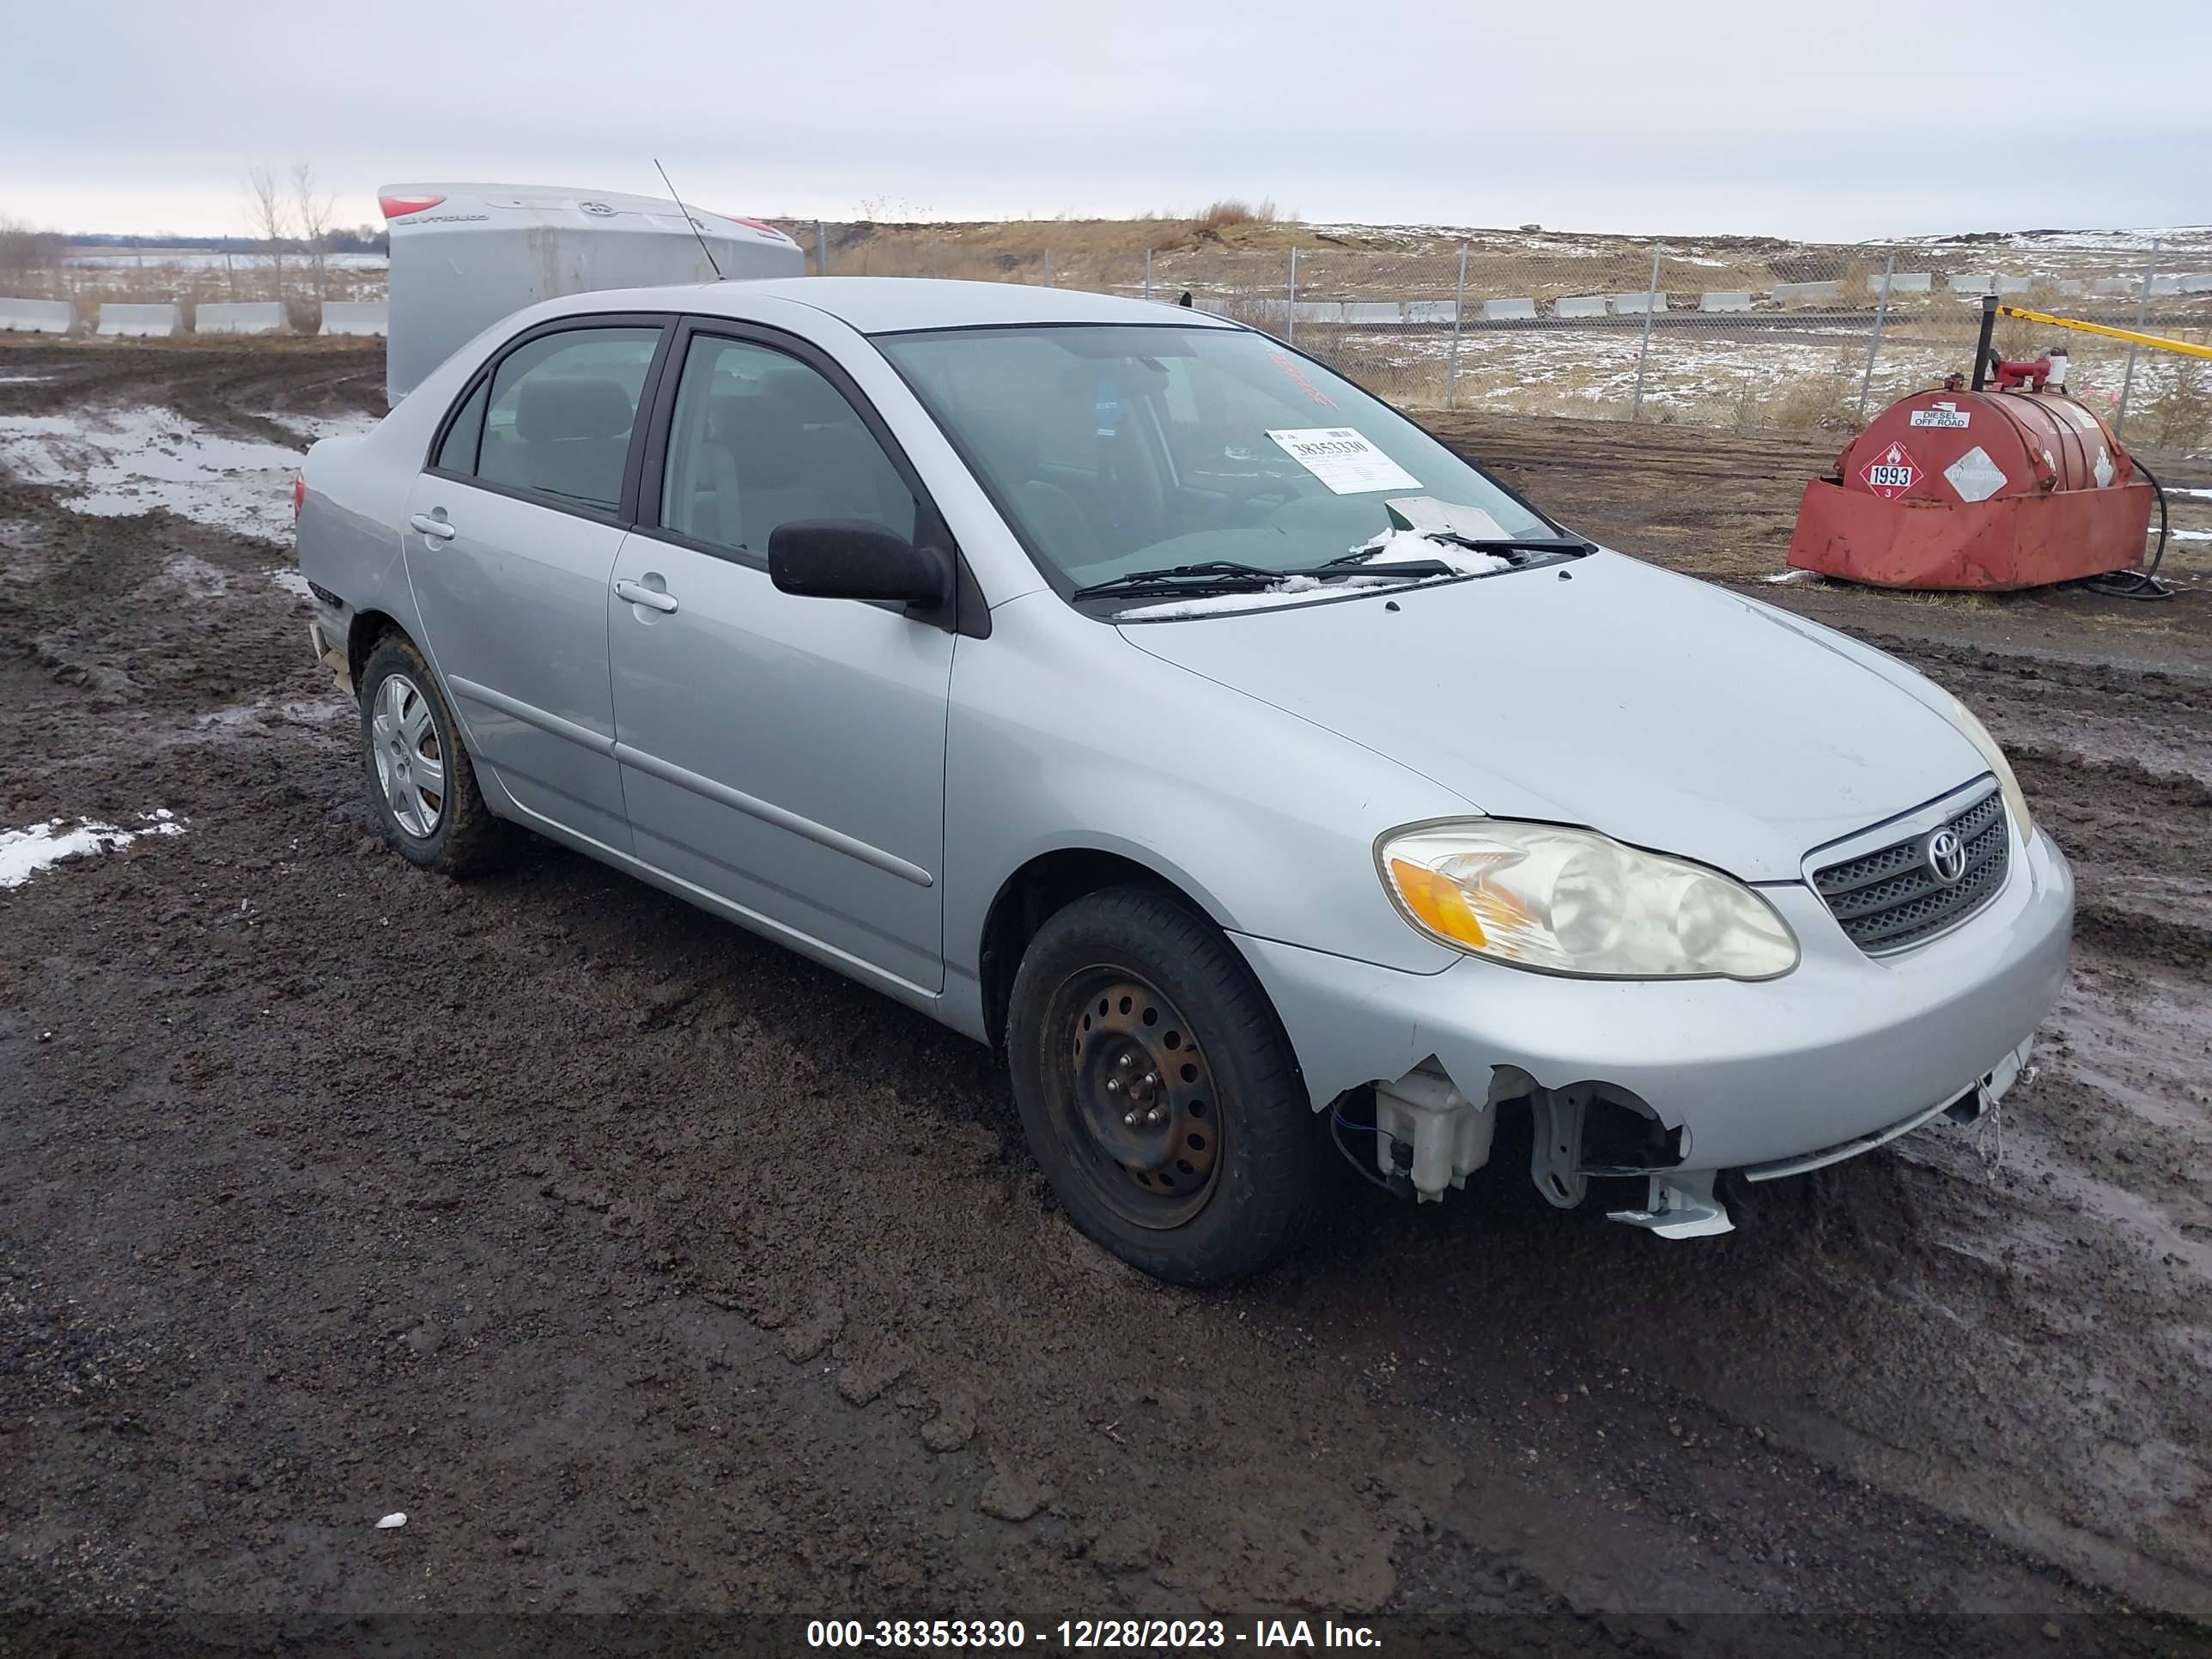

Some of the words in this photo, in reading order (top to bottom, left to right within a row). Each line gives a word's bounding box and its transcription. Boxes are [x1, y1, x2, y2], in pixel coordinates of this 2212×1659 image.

[1291, 441, 1369, 456] 38353330
[1873, 466, 1909, 485] 1993
[1884, 489, 1892, 498] 3
